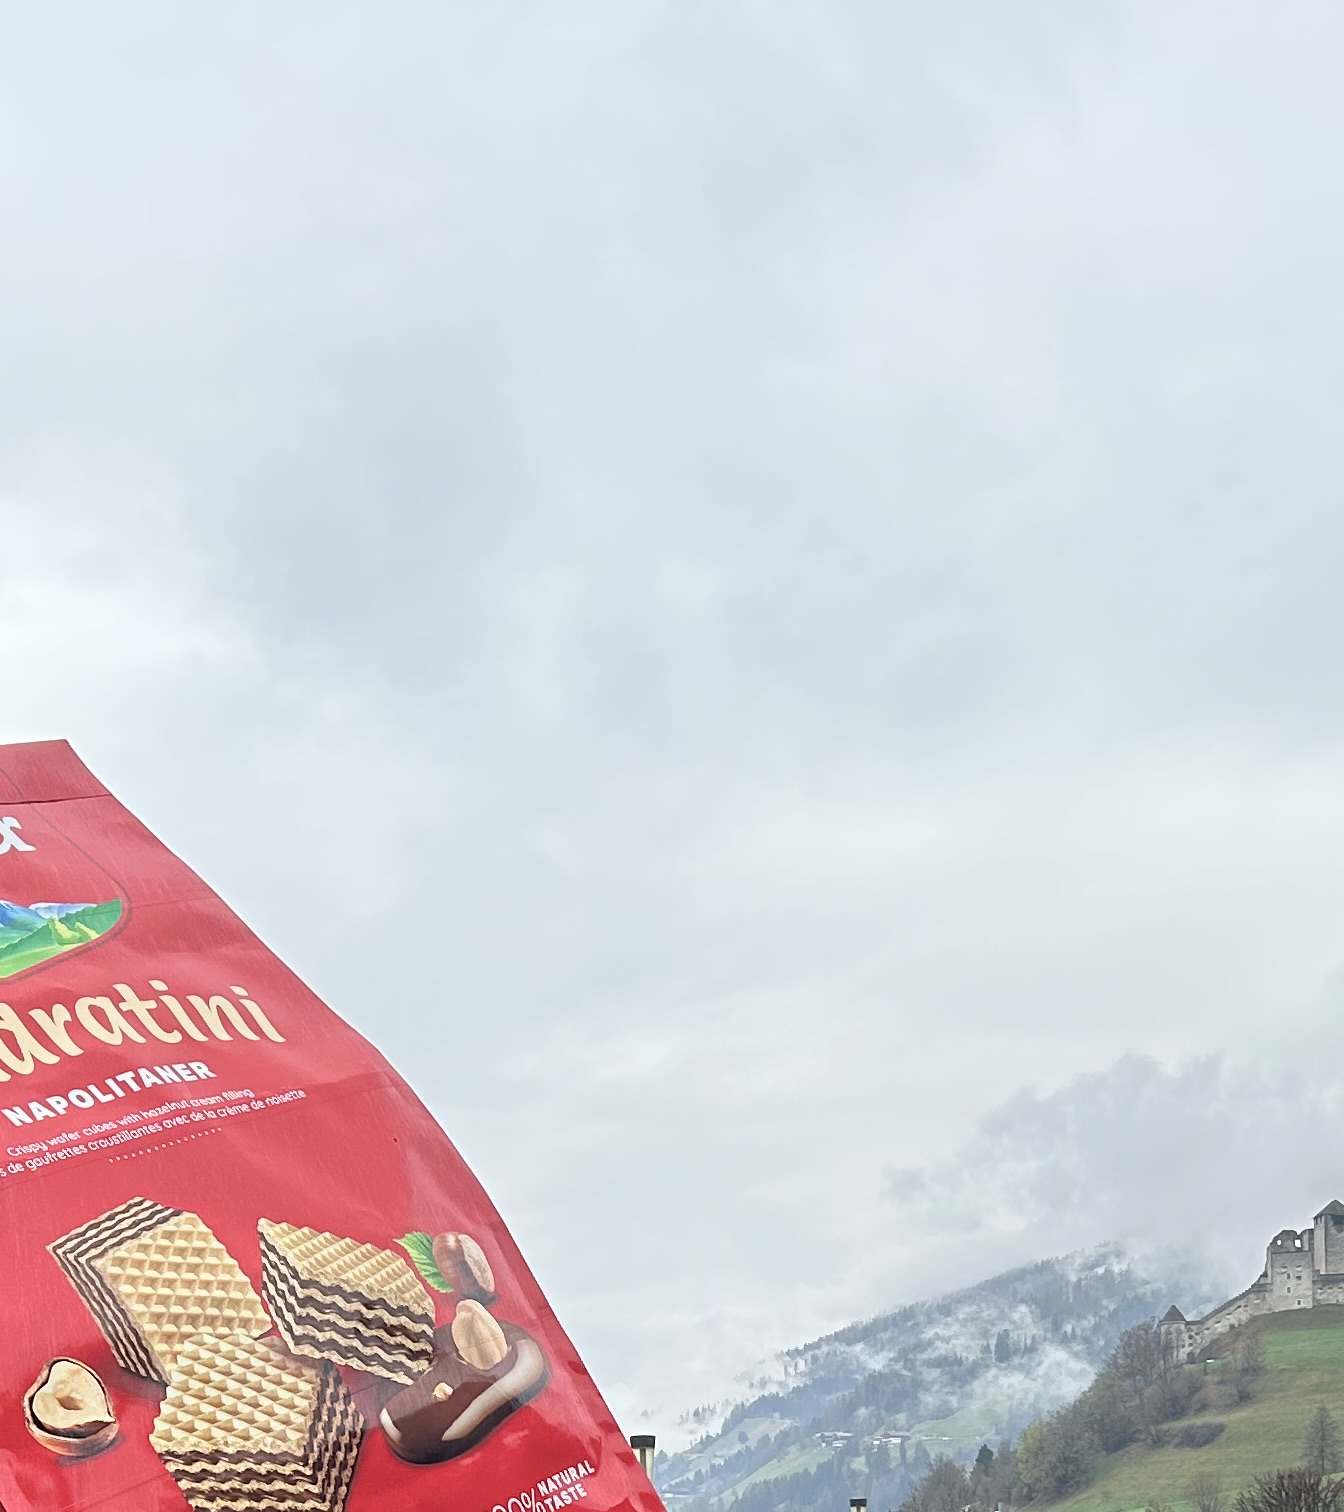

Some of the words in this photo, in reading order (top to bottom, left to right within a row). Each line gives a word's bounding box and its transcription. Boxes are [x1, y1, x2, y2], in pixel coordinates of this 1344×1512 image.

[1, 1061, 217, 1127] NAPOLITANER
[7, 1141, 48, 1157] Crispy
[46, 1131, 81, 1147] wafer
[82, 1121, 117, 1136] cubes
[118, 1112, 142, 1127] with
[140, 1099, 192, 1119] hazelnut
[190, 1095, 224, 1108] cream
[222, 1088, 255, 1102] filling
[7, 1162, 25, 1174] de
[25, 1143, 88, 1172] gaufrettes
[87, 1121, 163, 1151] croustillantes
[162, 1115, 191, 1129] avec
[190, 1110, 205, 1122] de
[204, 1107, 217, 1120] la
[216, 1102, 251, 1118] crème
[251, 1098, 266, 1110] de
[265, 1089, 307, 1106] noisette
[536, 1460, 595, 1497] NATURAL
[544, 1483, 588, 1512] TASTE
